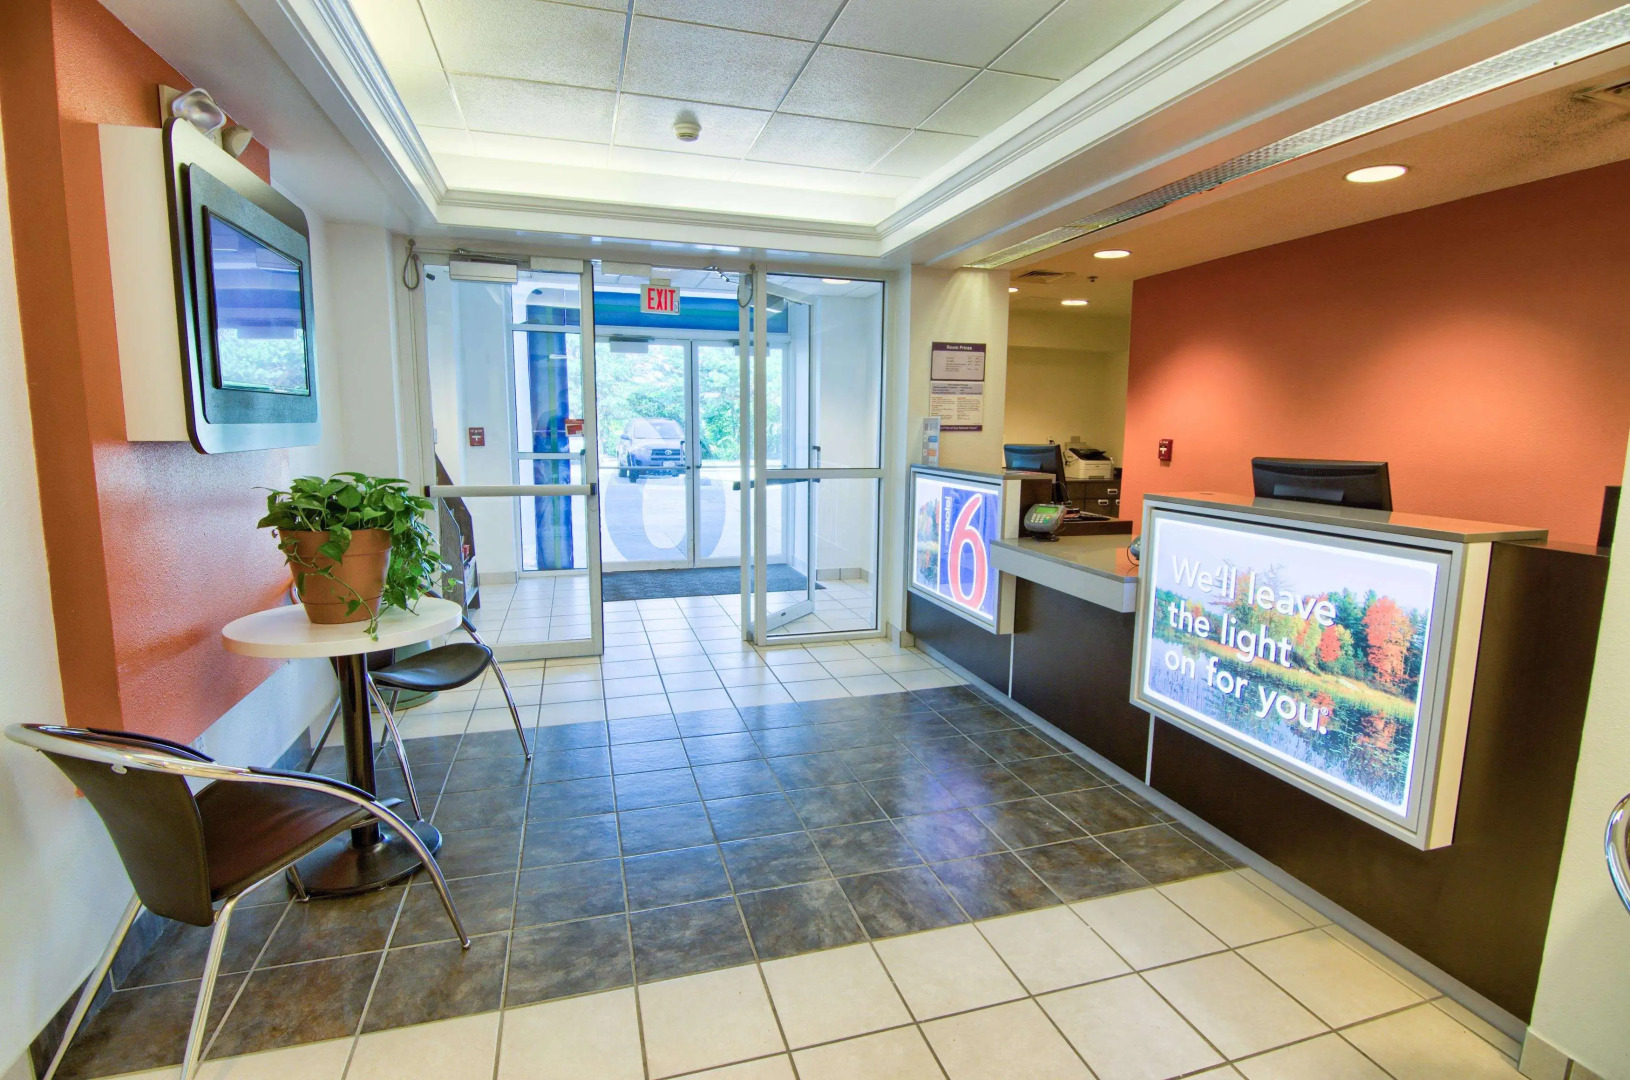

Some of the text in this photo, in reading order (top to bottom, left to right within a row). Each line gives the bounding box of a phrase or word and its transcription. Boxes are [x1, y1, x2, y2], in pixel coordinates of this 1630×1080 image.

[647, 287, 676, 312] EXIT
[944, 496, 952, 532] motel
[947, 493, 988, 611] 6
[1172, 555, 1337, 626] We'll leave
[1167, 599, 1293, 669] the light
[1164, 650, 1196, 679] on
[1206, 656, 1249, 700] for
